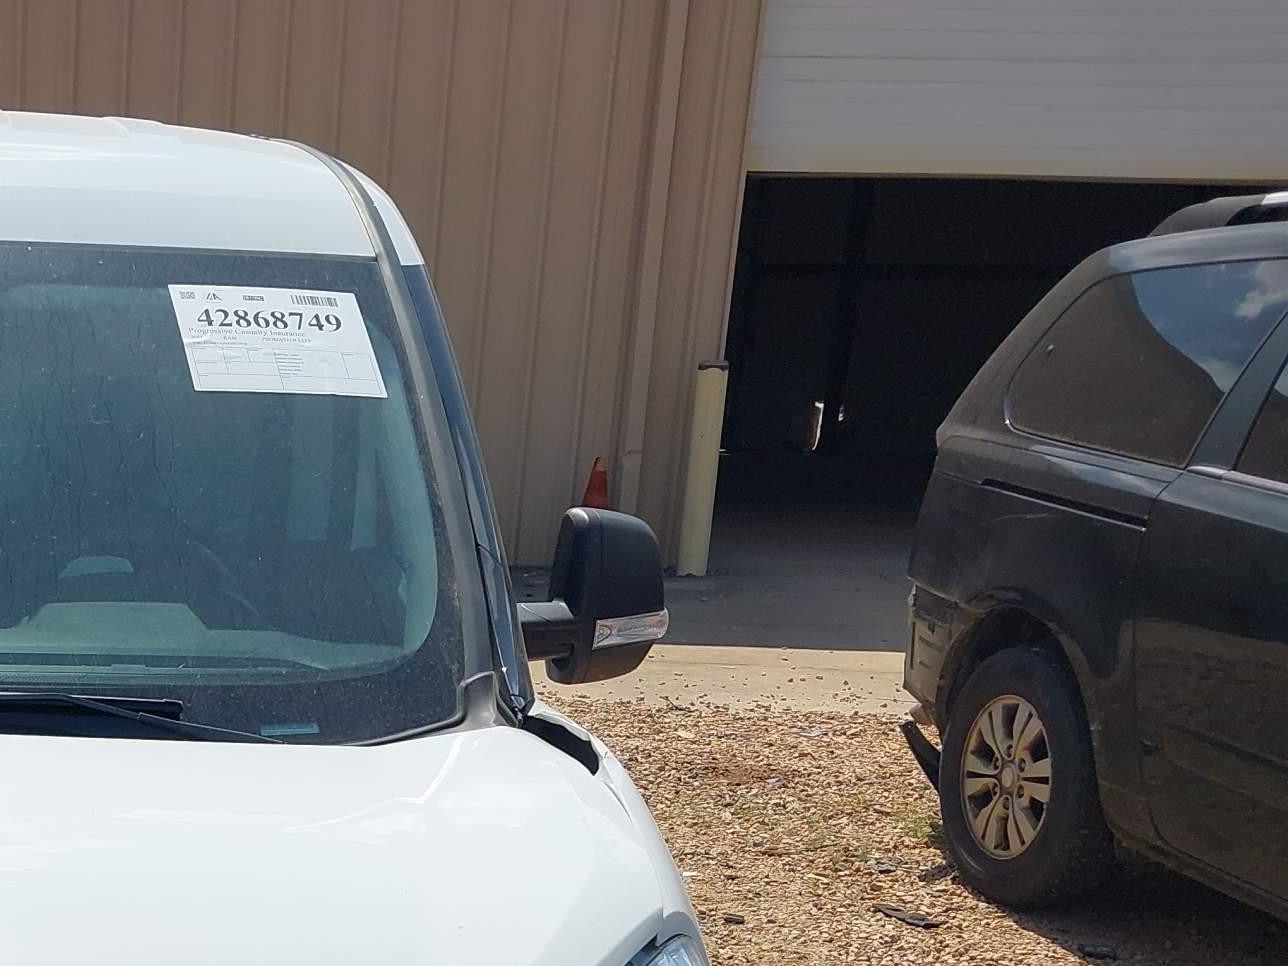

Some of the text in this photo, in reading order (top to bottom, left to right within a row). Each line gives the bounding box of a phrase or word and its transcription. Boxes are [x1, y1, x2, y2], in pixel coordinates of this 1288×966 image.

[197, 308, 342, 333] 42868749
[189, 327, 233, 335] Progressive
[234, 328, 268, 337] Casualty
